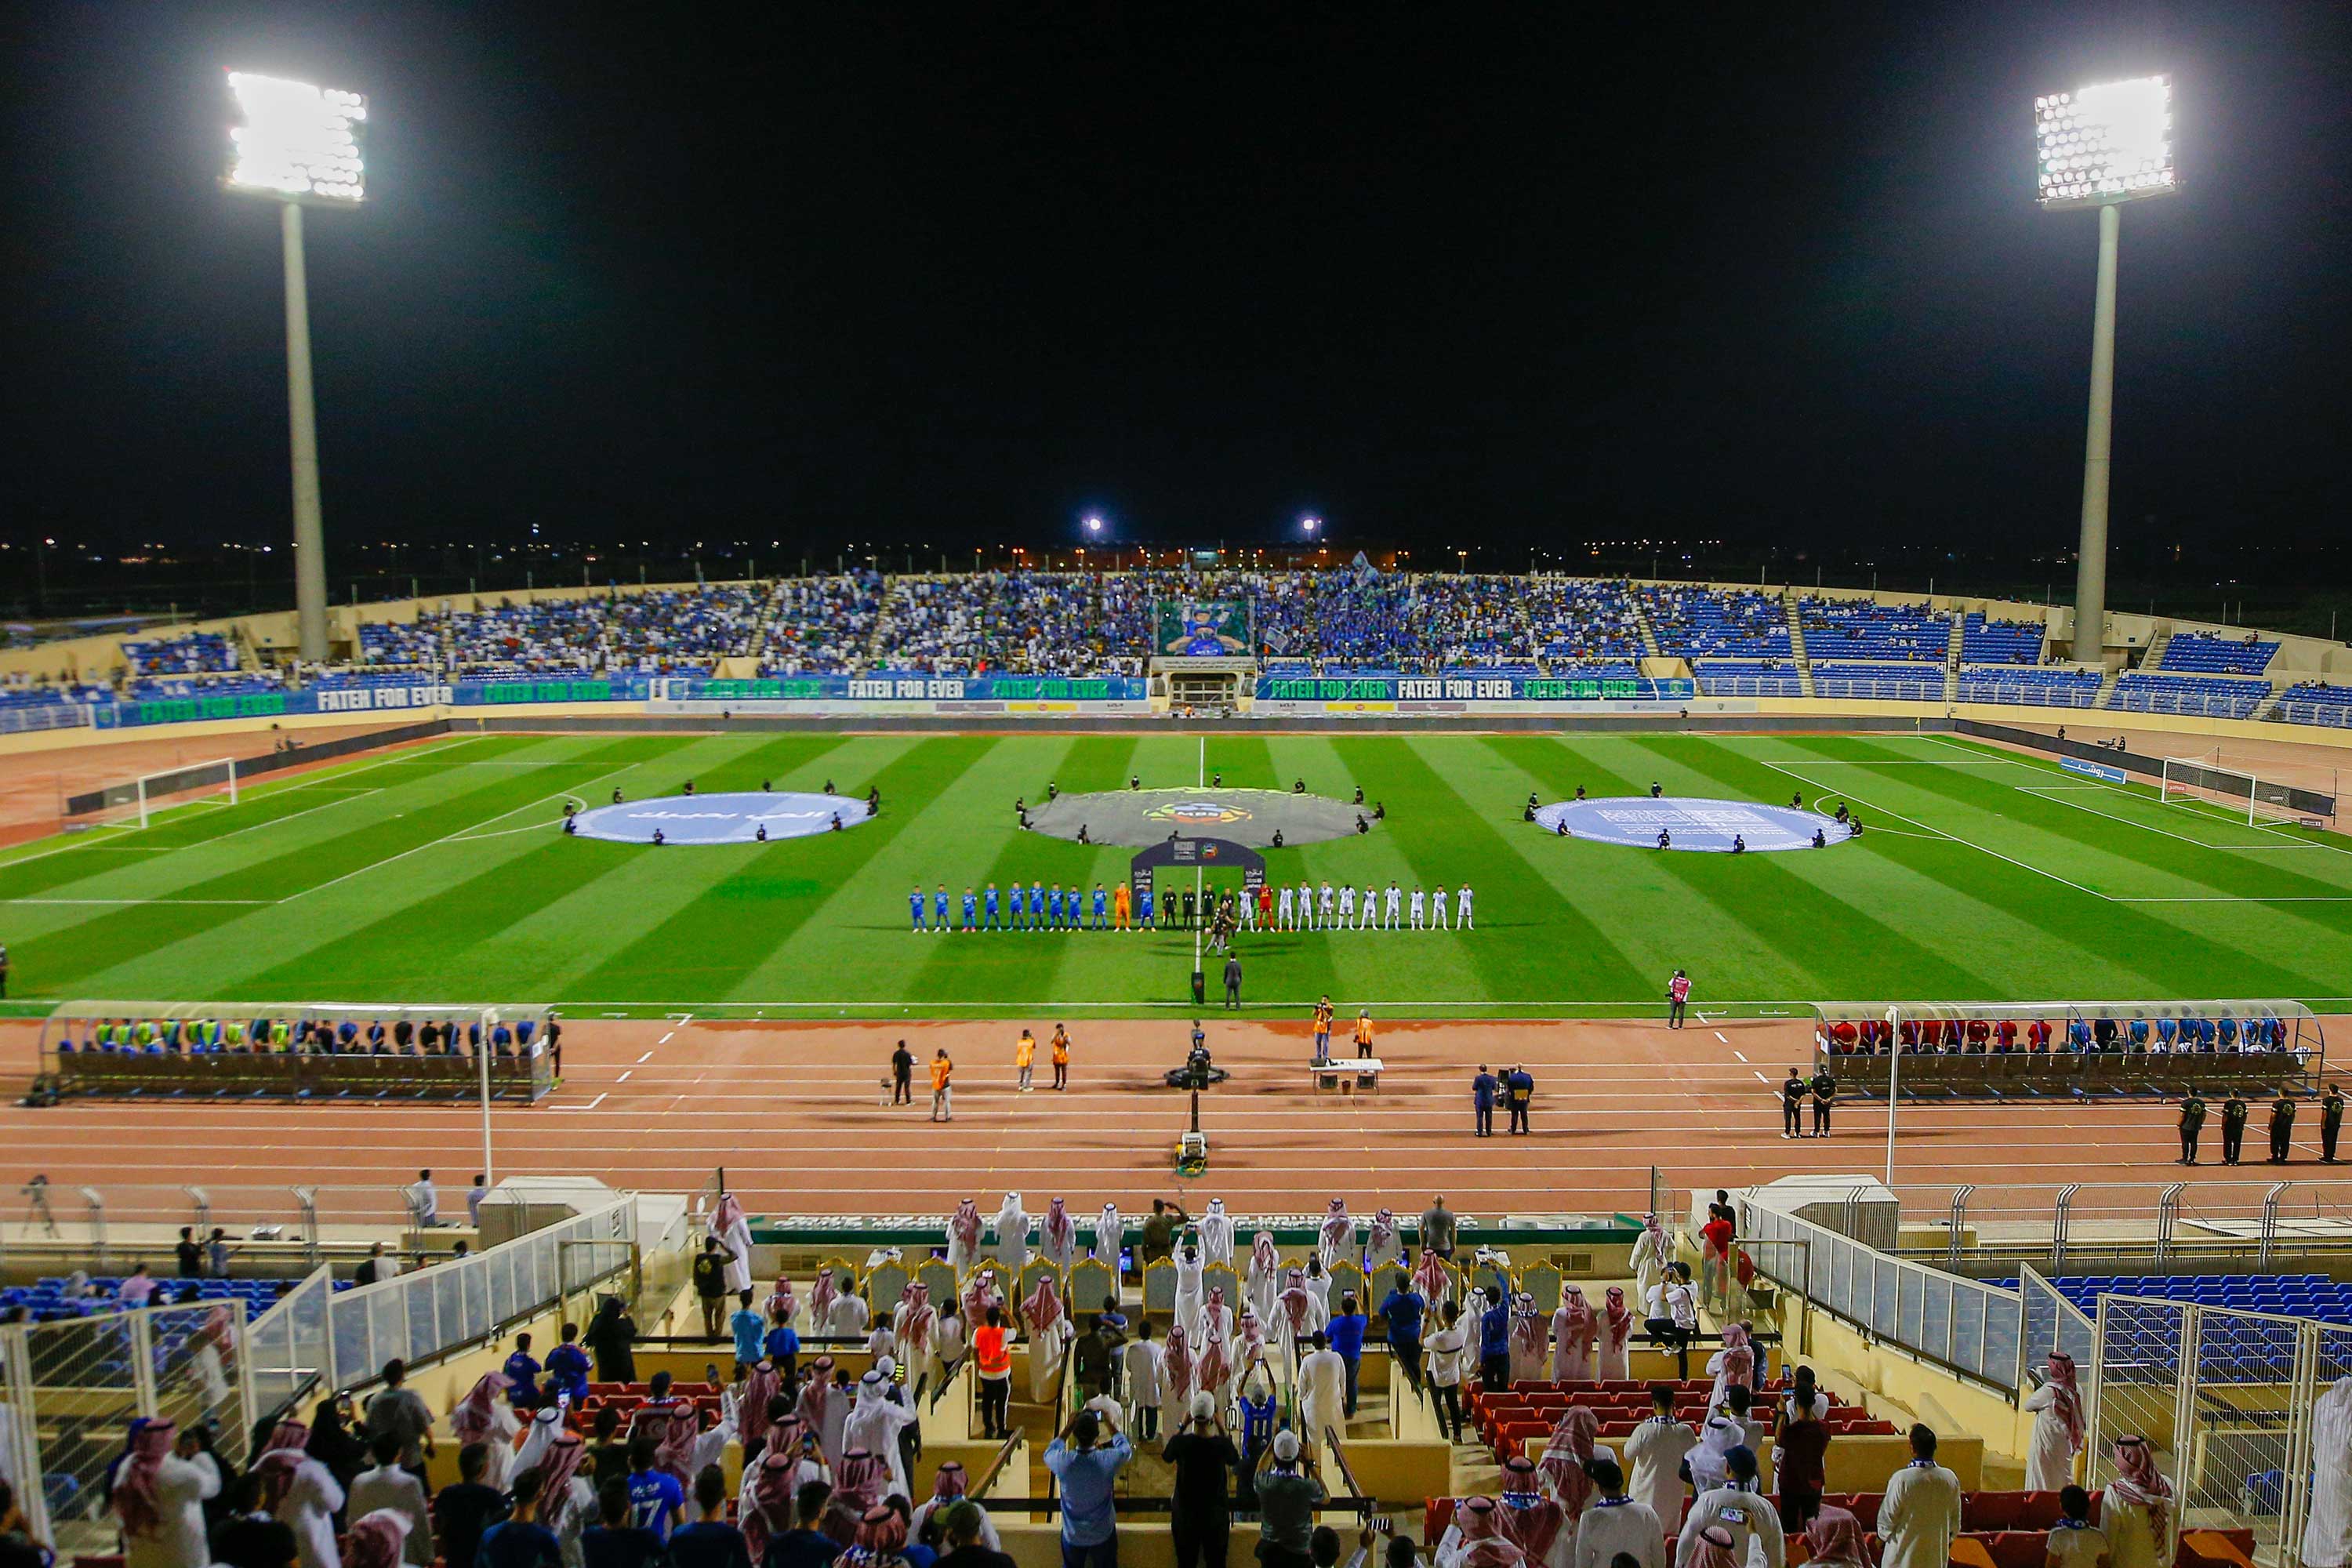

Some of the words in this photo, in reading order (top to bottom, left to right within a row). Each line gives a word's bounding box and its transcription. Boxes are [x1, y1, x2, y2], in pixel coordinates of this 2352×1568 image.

[318, 690, 371, 710] FATEH
[374, 688, 408, 707] FOR
[411, 686, 453, 705] EVER
[848, 680, 892, 698] FATEH
[896, 680, 924, 698] FOR
[928, 680, 964, 698] EVER
[992, 680, 1036, 698] FATEH
[1040, 680, 1067, 698] FOR
[1072, 680, 1107, 698] EVER
[1272, 680, 1315, 698] FATEH
[1319, 680, 1346, 698] FOR
[1350, 680, 1385, 698] EVER
[1398, 680, 1441, 698] FATEH
[1446, 680, 1473, 698] FOR
[1476, 680, 1512, 698] EVER
[1524, 680, 1566, 698] FATEH
[1571, 680, 1598, 698] FOR
[1602, 680, 1637, 698] EVER
[631, 1498, 663, 1529] 17
